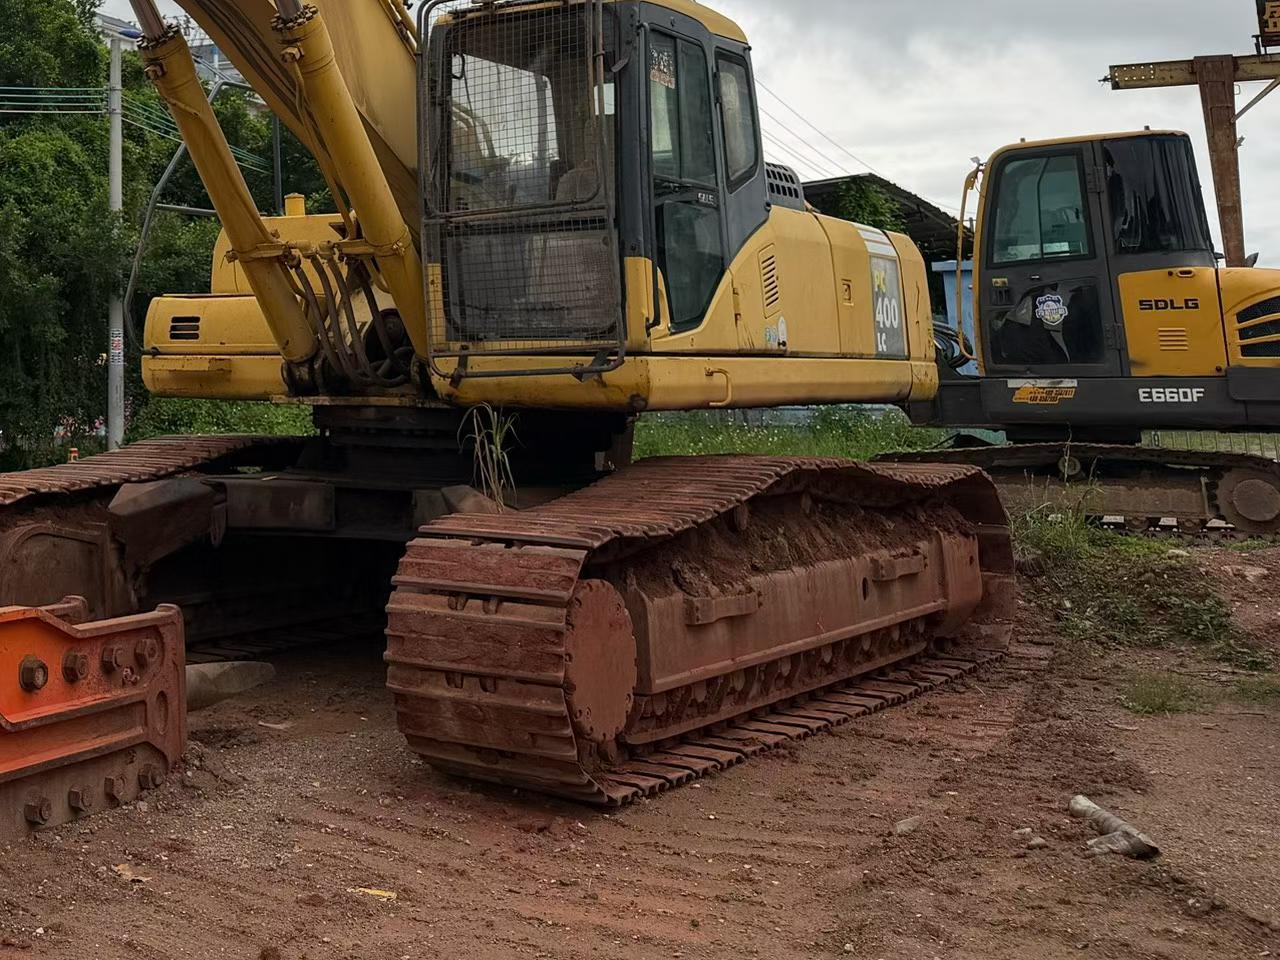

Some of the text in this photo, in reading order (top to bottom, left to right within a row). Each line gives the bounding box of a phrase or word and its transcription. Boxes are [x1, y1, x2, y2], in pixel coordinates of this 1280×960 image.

[874, 270, 886, 292] PC
[875, 297, 899, 329] 400
[1138, 298, 1200, 311] SDLG
[877, 332, 887, 352] LC
[1138, 388, 1205, 403] E660F
